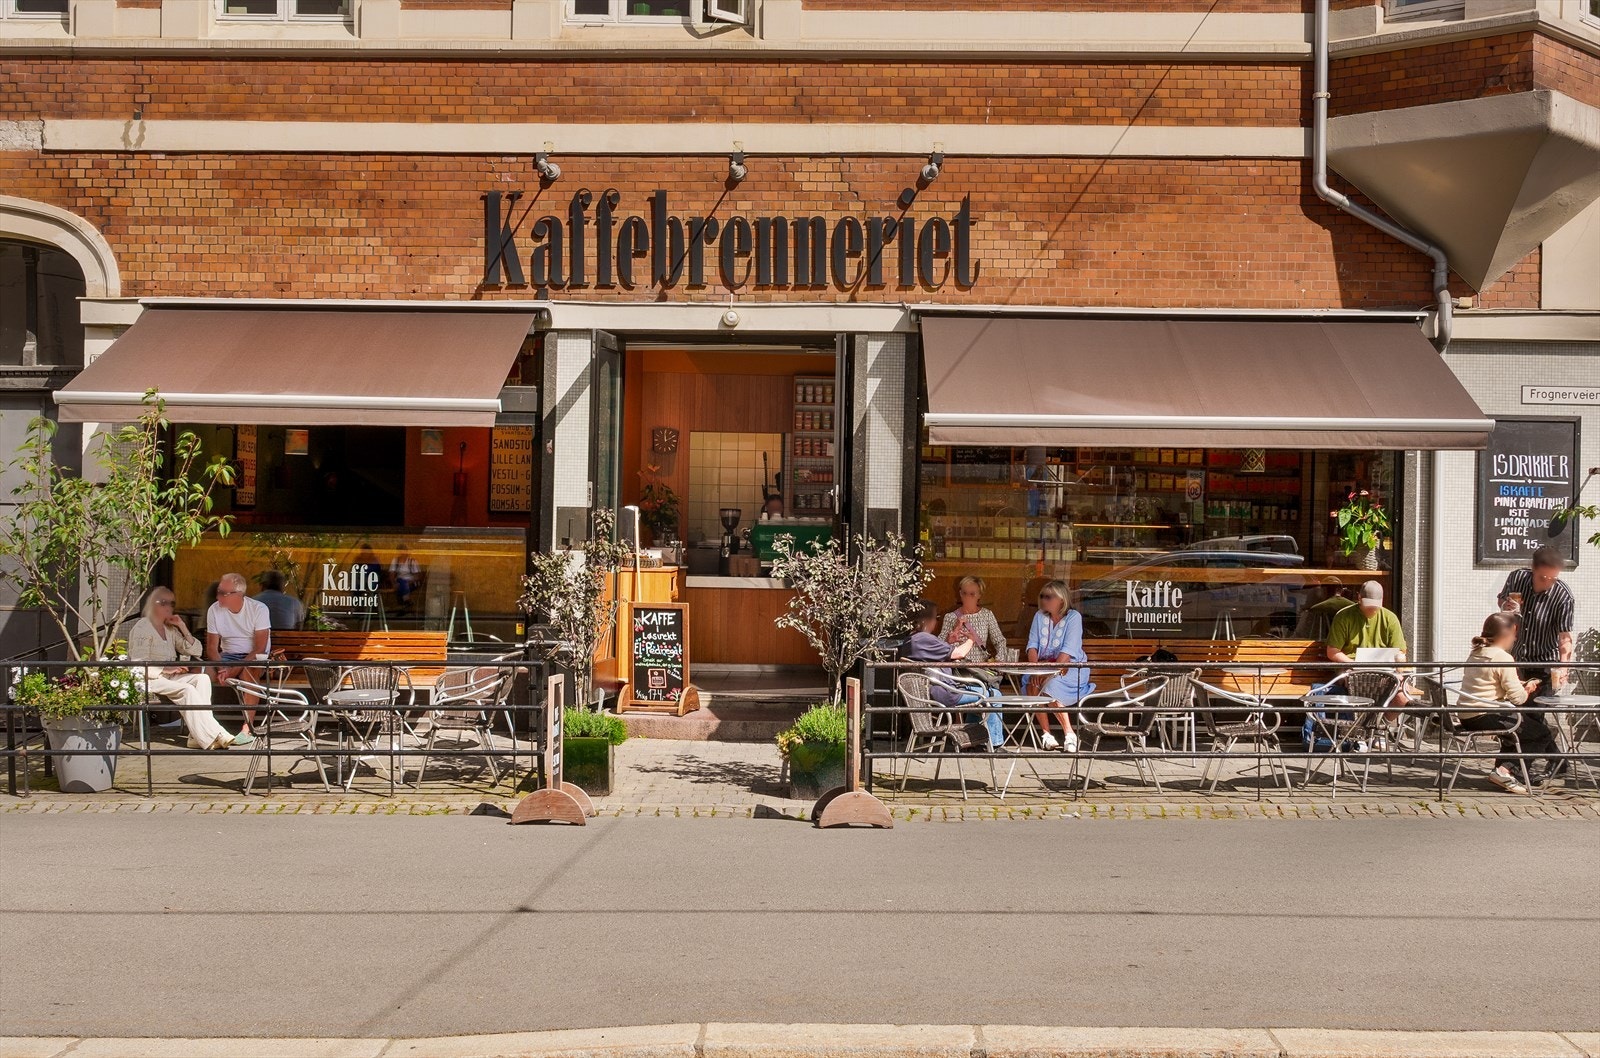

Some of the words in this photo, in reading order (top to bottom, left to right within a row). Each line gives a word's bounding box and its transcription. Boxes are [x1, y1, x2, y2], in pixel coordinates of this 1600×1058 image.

[482, 188, 980, 288] Kaffebrenneriet
[493, 439, 530, 450] SANDSTU
[492, 454, 513, 464] LILLE
[492, 468, 518, 480] VESTLI
[492, 484, 520, 495] FOSSUM
[1500, 485, 1544, 497] ISKAFFE
[491, 498, 520, 510] ROMSÅS
[1494, 497, 1517, 508] PINK
[1509, 508, 1530, 518] ISTE
[1494, 517, 1550, 529] LIMONADE
[1501, 526, 1529, 537] JUICE
[1496, 538, 1517, 552] FRA
[322, 563, 379, 592] Kaffe
[322, 592, 378, 607] brenneriet
[1125, 580, 1183, 608] Kaffe
[641, 610, 676, 625] KAFFE
[1125, 609, 1182, 624] brenneriet
